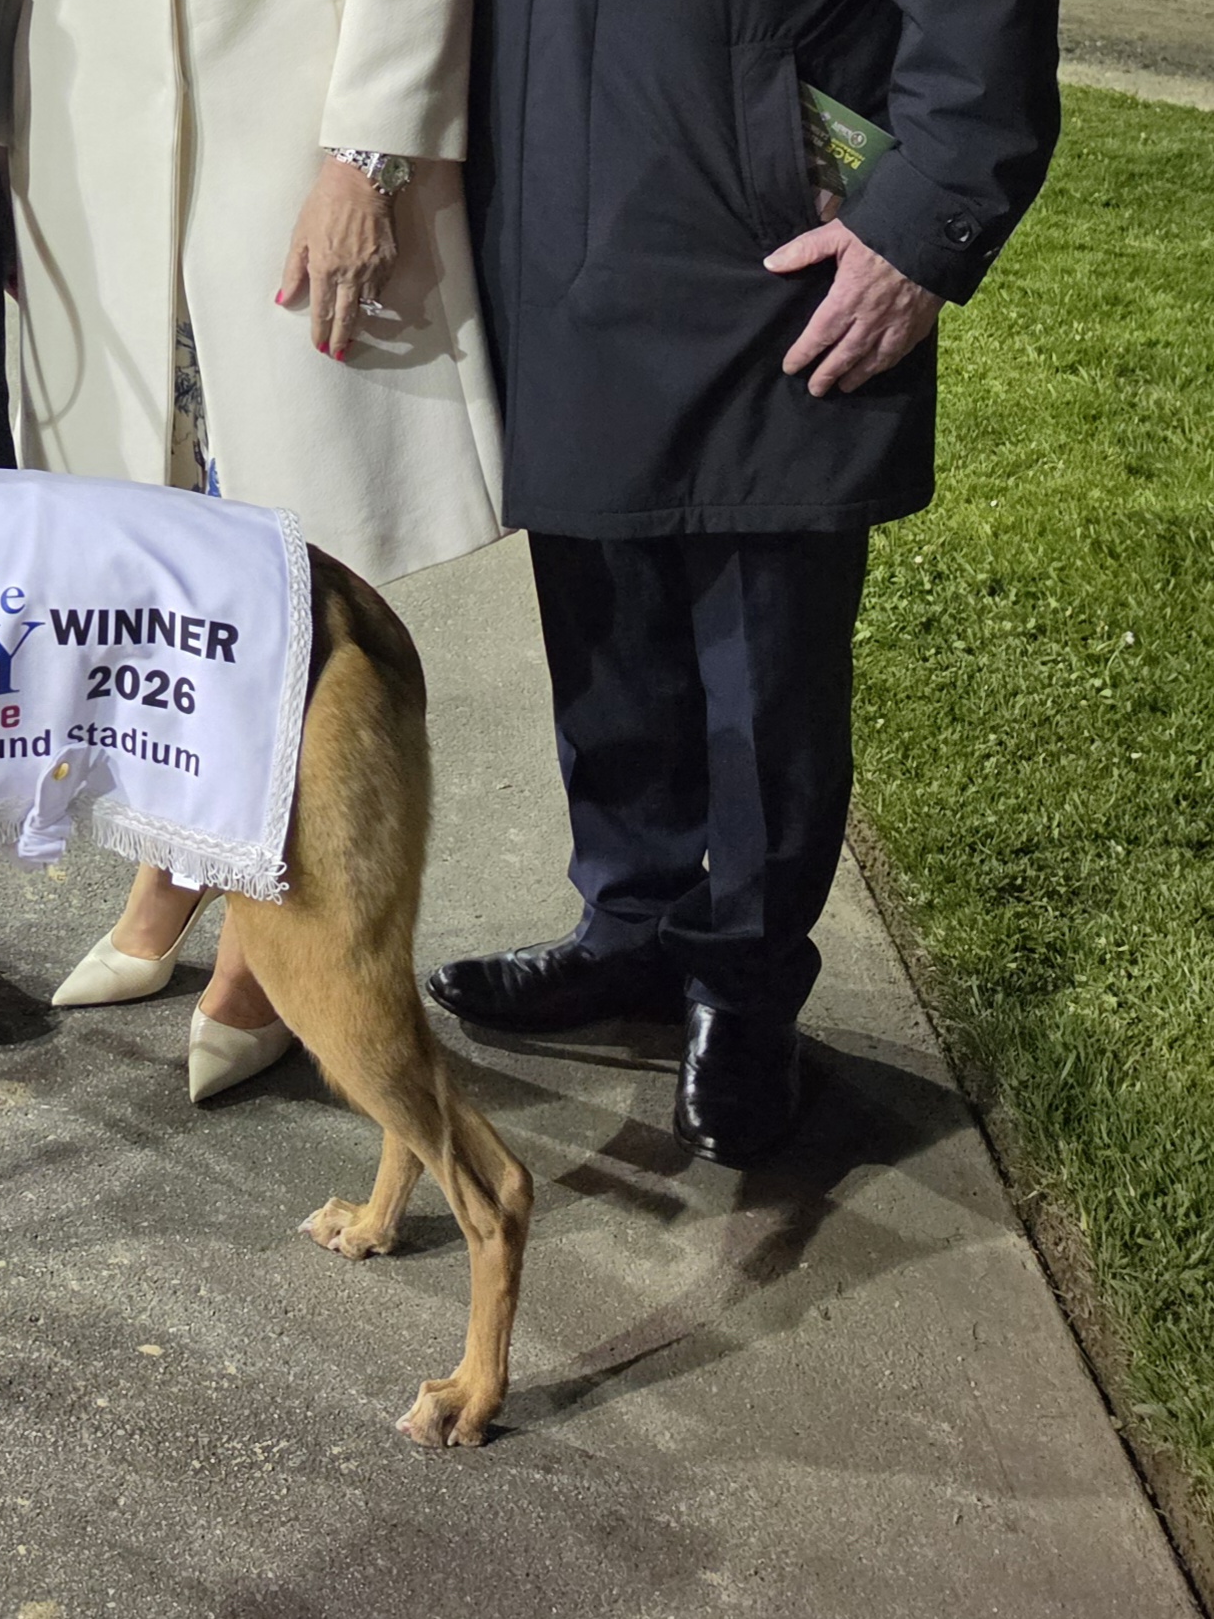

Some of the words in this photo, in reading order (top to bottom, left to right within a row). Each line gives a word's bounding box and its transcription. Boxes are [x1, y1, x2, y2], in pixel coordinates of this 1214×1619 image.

[826, 142, 862, 170] RACE
[49, 608, 239, 664] WINNER
[86, 664, 196, 715] 2026
